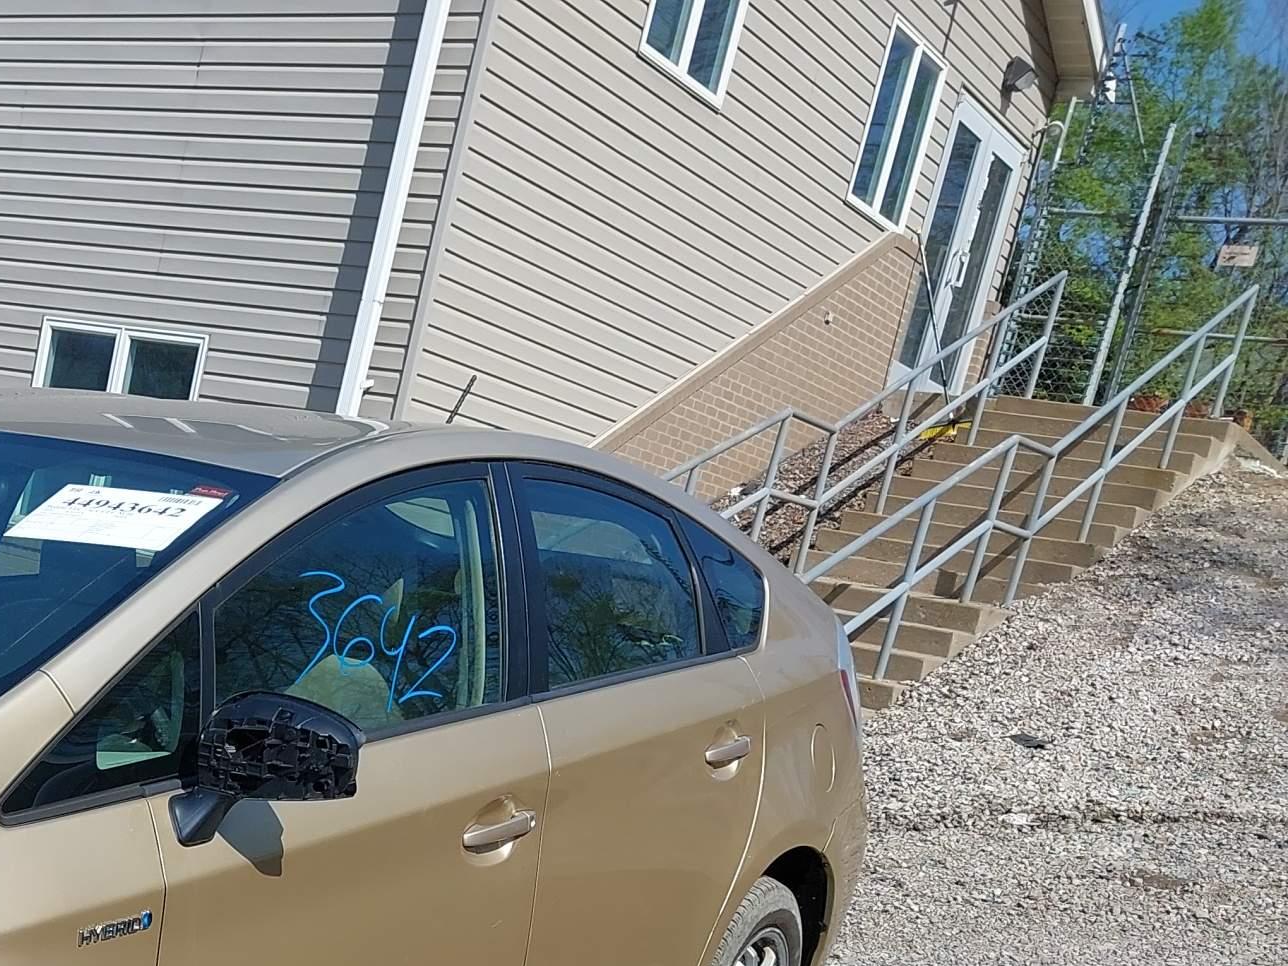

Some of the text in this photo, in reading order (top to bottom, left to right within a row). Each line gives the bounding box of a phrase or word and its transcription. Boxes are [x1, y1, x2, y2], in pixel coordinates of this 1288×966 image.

[63, 497, 187, 517] 44943642
[297, 570, 457, 713] 3642
[77, 917, 142, 947] HYBRID
